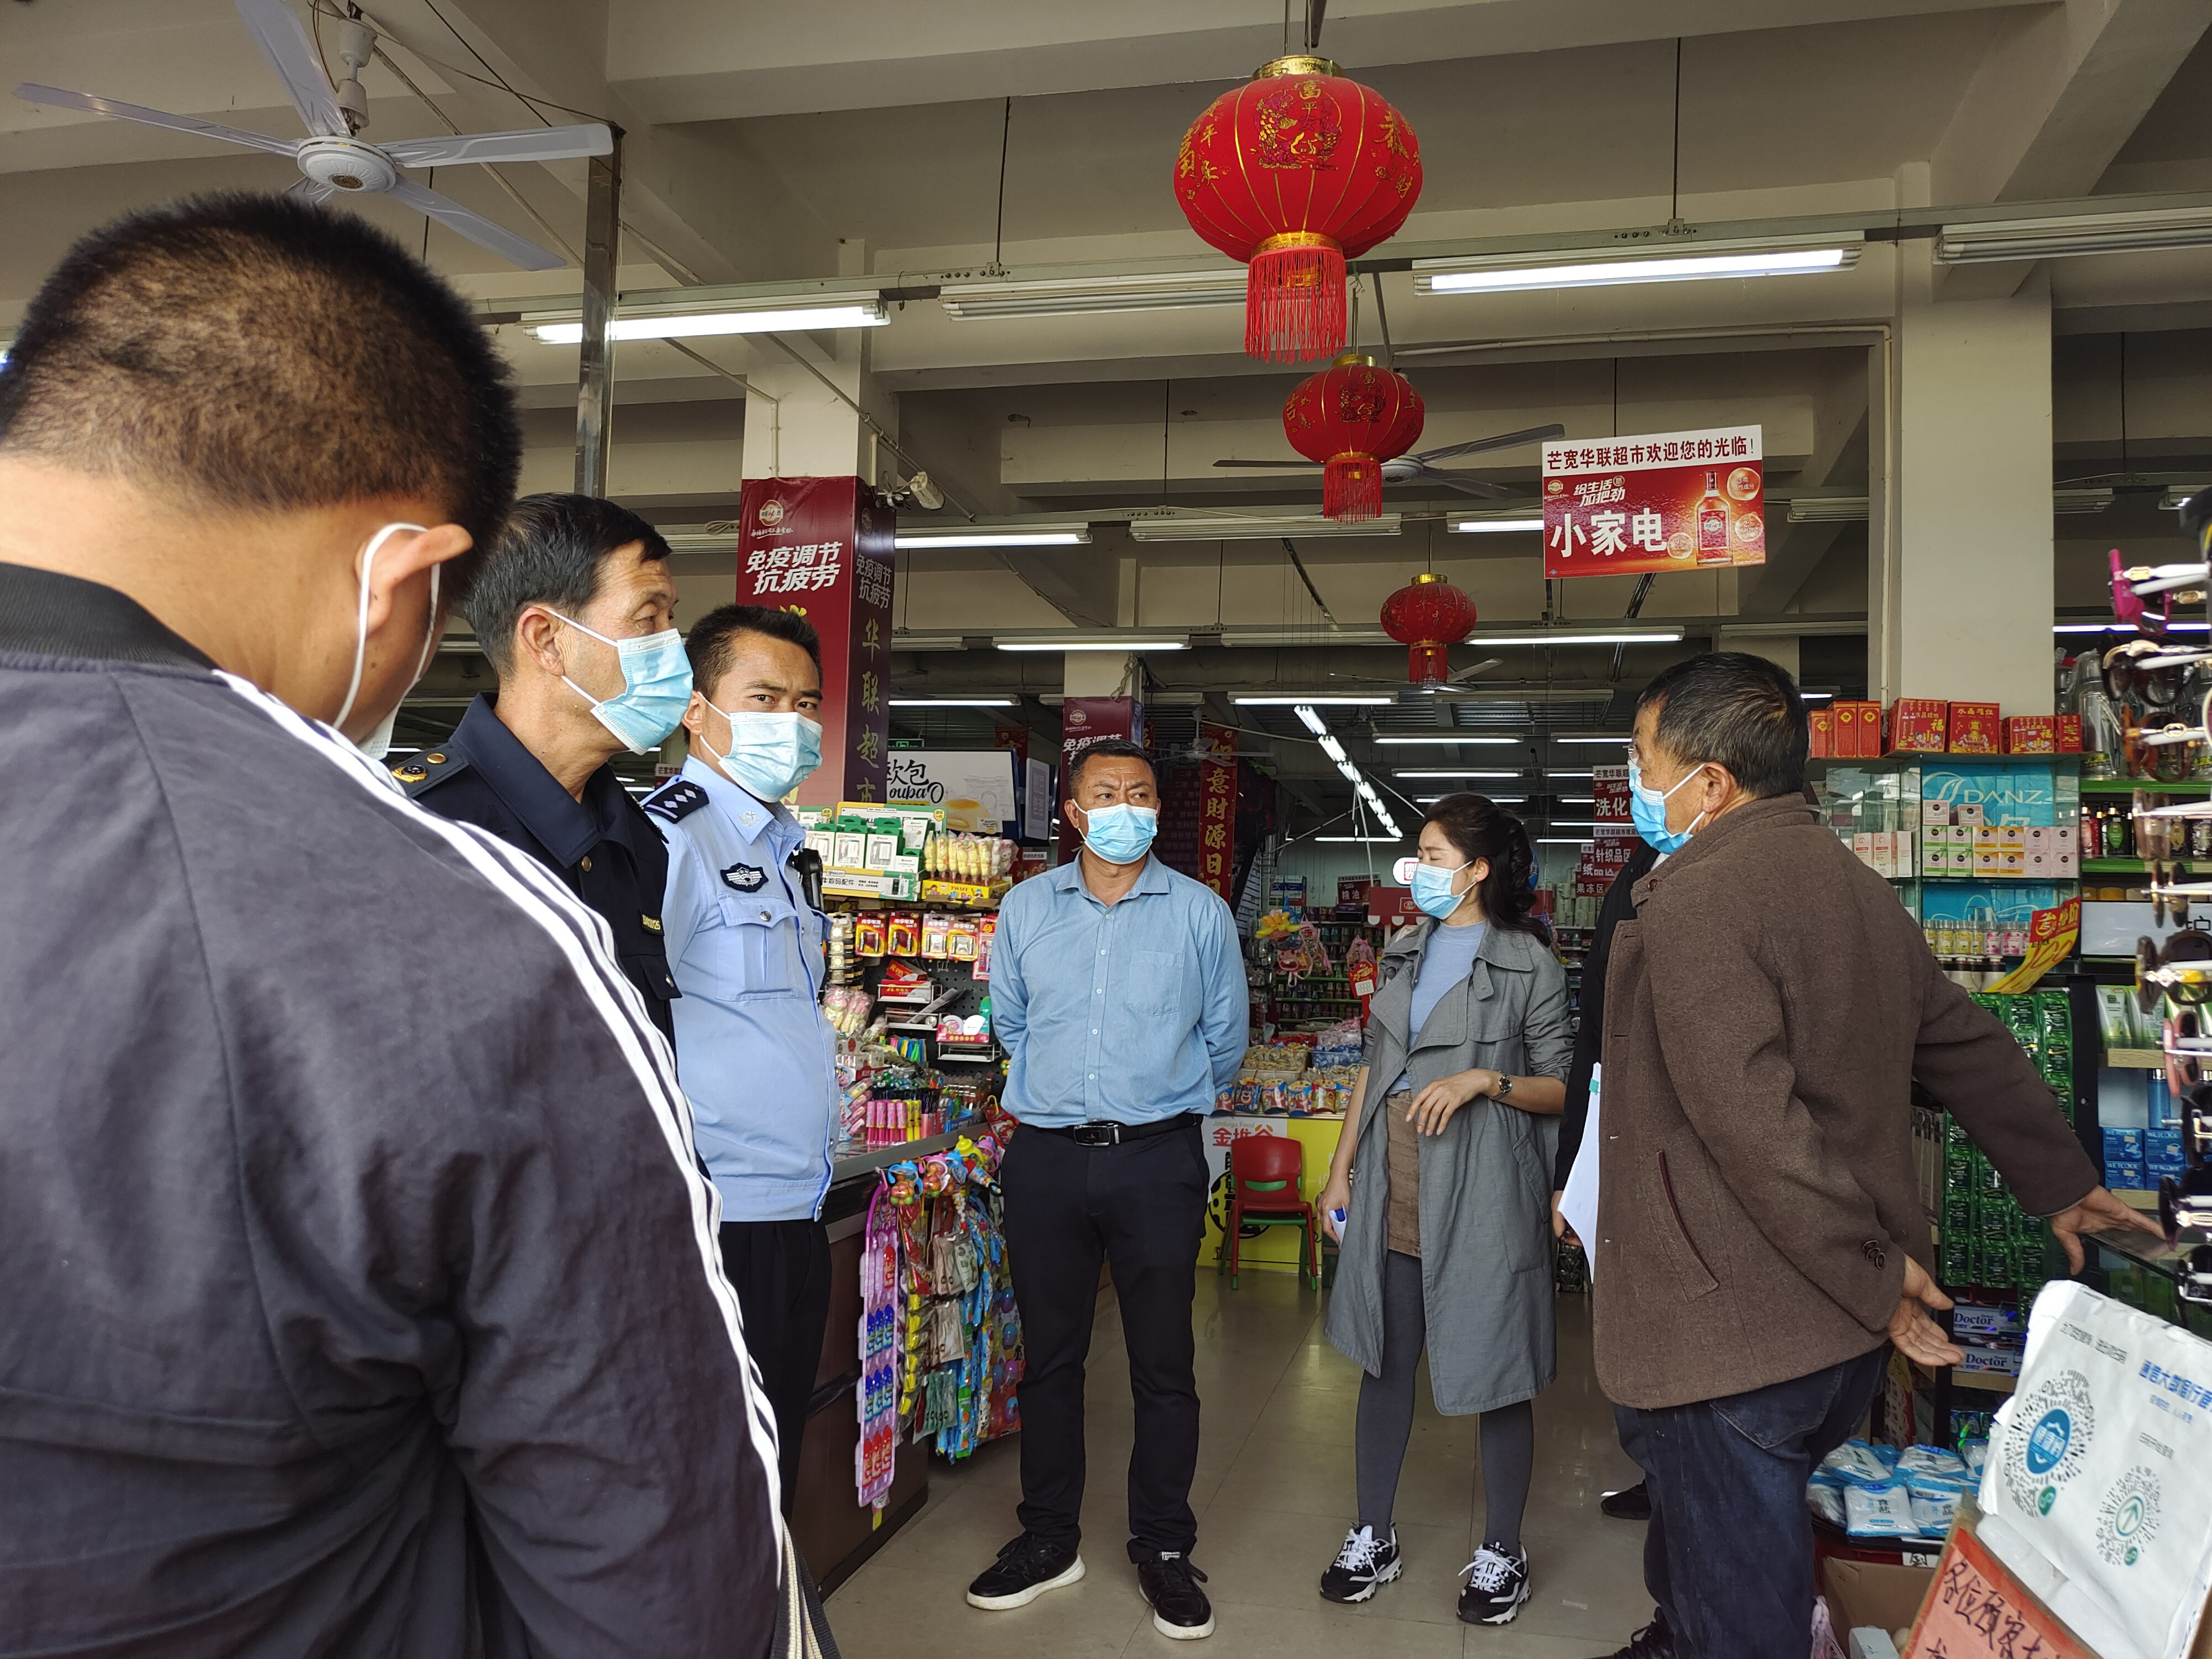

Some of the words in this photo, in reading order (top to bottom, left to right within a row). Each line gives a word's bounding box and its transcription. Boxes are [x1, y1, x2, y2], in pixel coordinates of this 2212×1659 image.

[1573, 478, 1613, 495] 给生活
[1579, 486, 1626, 507] 加把劲
[1550, 508, 1667, 557] 小家电
[745, 541, 843, 573] 免疫调节
[856, 553, 892, 584] 免疫调节
[753, 563, 841, 595] 抗疲劳
[858, 578, 890, 609] 抗疲劳
[857, 617, 881, 802] 华联超市
[1931, 718, 1944, 731] 福
[1596, 797, 1632, 817] 洗化
[1596, 848, 1631, 863] 针织品区
[1577, 883, 1604, 894] 果冻区
[1954, 1313, 1994, 1325] Doctor
[1965, 1354, 2007, 1367] Doctor
